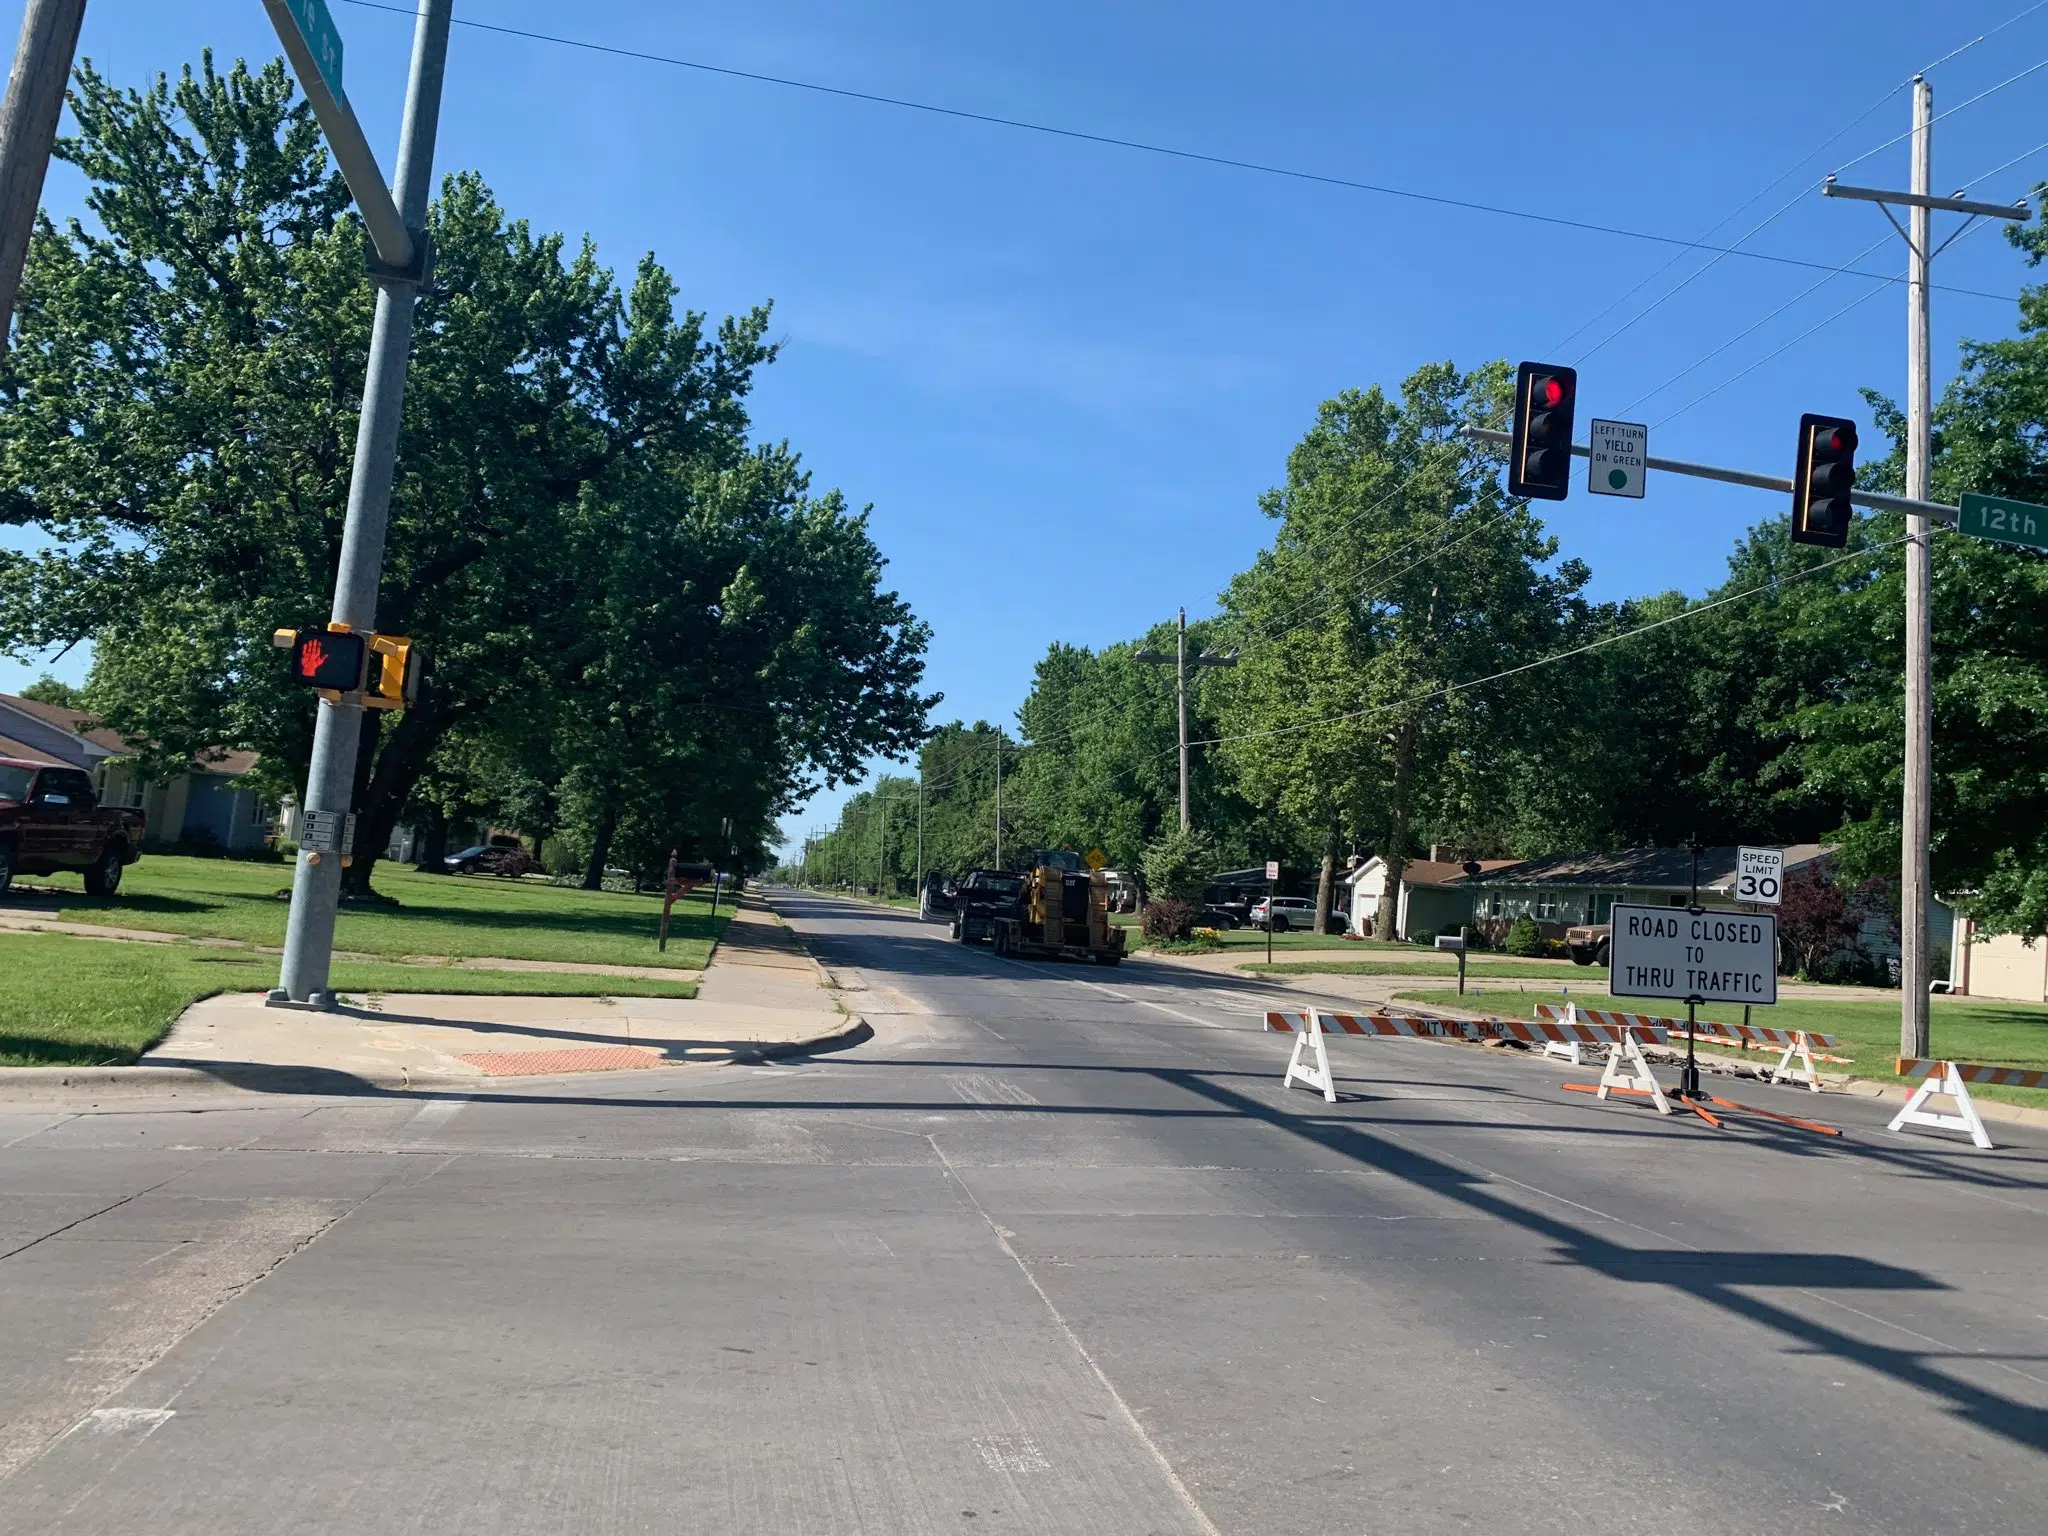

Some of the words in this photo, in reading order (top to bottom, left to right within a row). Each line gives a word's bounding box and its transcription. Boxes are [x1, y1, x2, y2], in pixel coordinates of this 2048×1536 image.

[1595, 425, 1616, 436] LEFT
[1620, 428, 1644, 439] TURN
[1605, 439, 1634, 452] YIELD
[1595, 453, 1608, 462] ON
[1613, 455, 1641, 466] GREEN
[1980, 506, 2036, 536] 12th
[1742, 853, 1779, 864] SPEED
[1745, 865, 1774, 875] LIMIT
[1739, 876, 1778, 897] 30
[1629, 916, 1678, 938] ROAD
[1691, 920, 1761, 944] CLOSED
[1685, 946, 1704, 963] TO
[1626, 966, 1674, 988] THRU
[1686, 969, 1762, 993] TRAFFIC
[1416, 1021, 1448, 1036] CITY
[1452, 1022, 1469, 1036] OF
